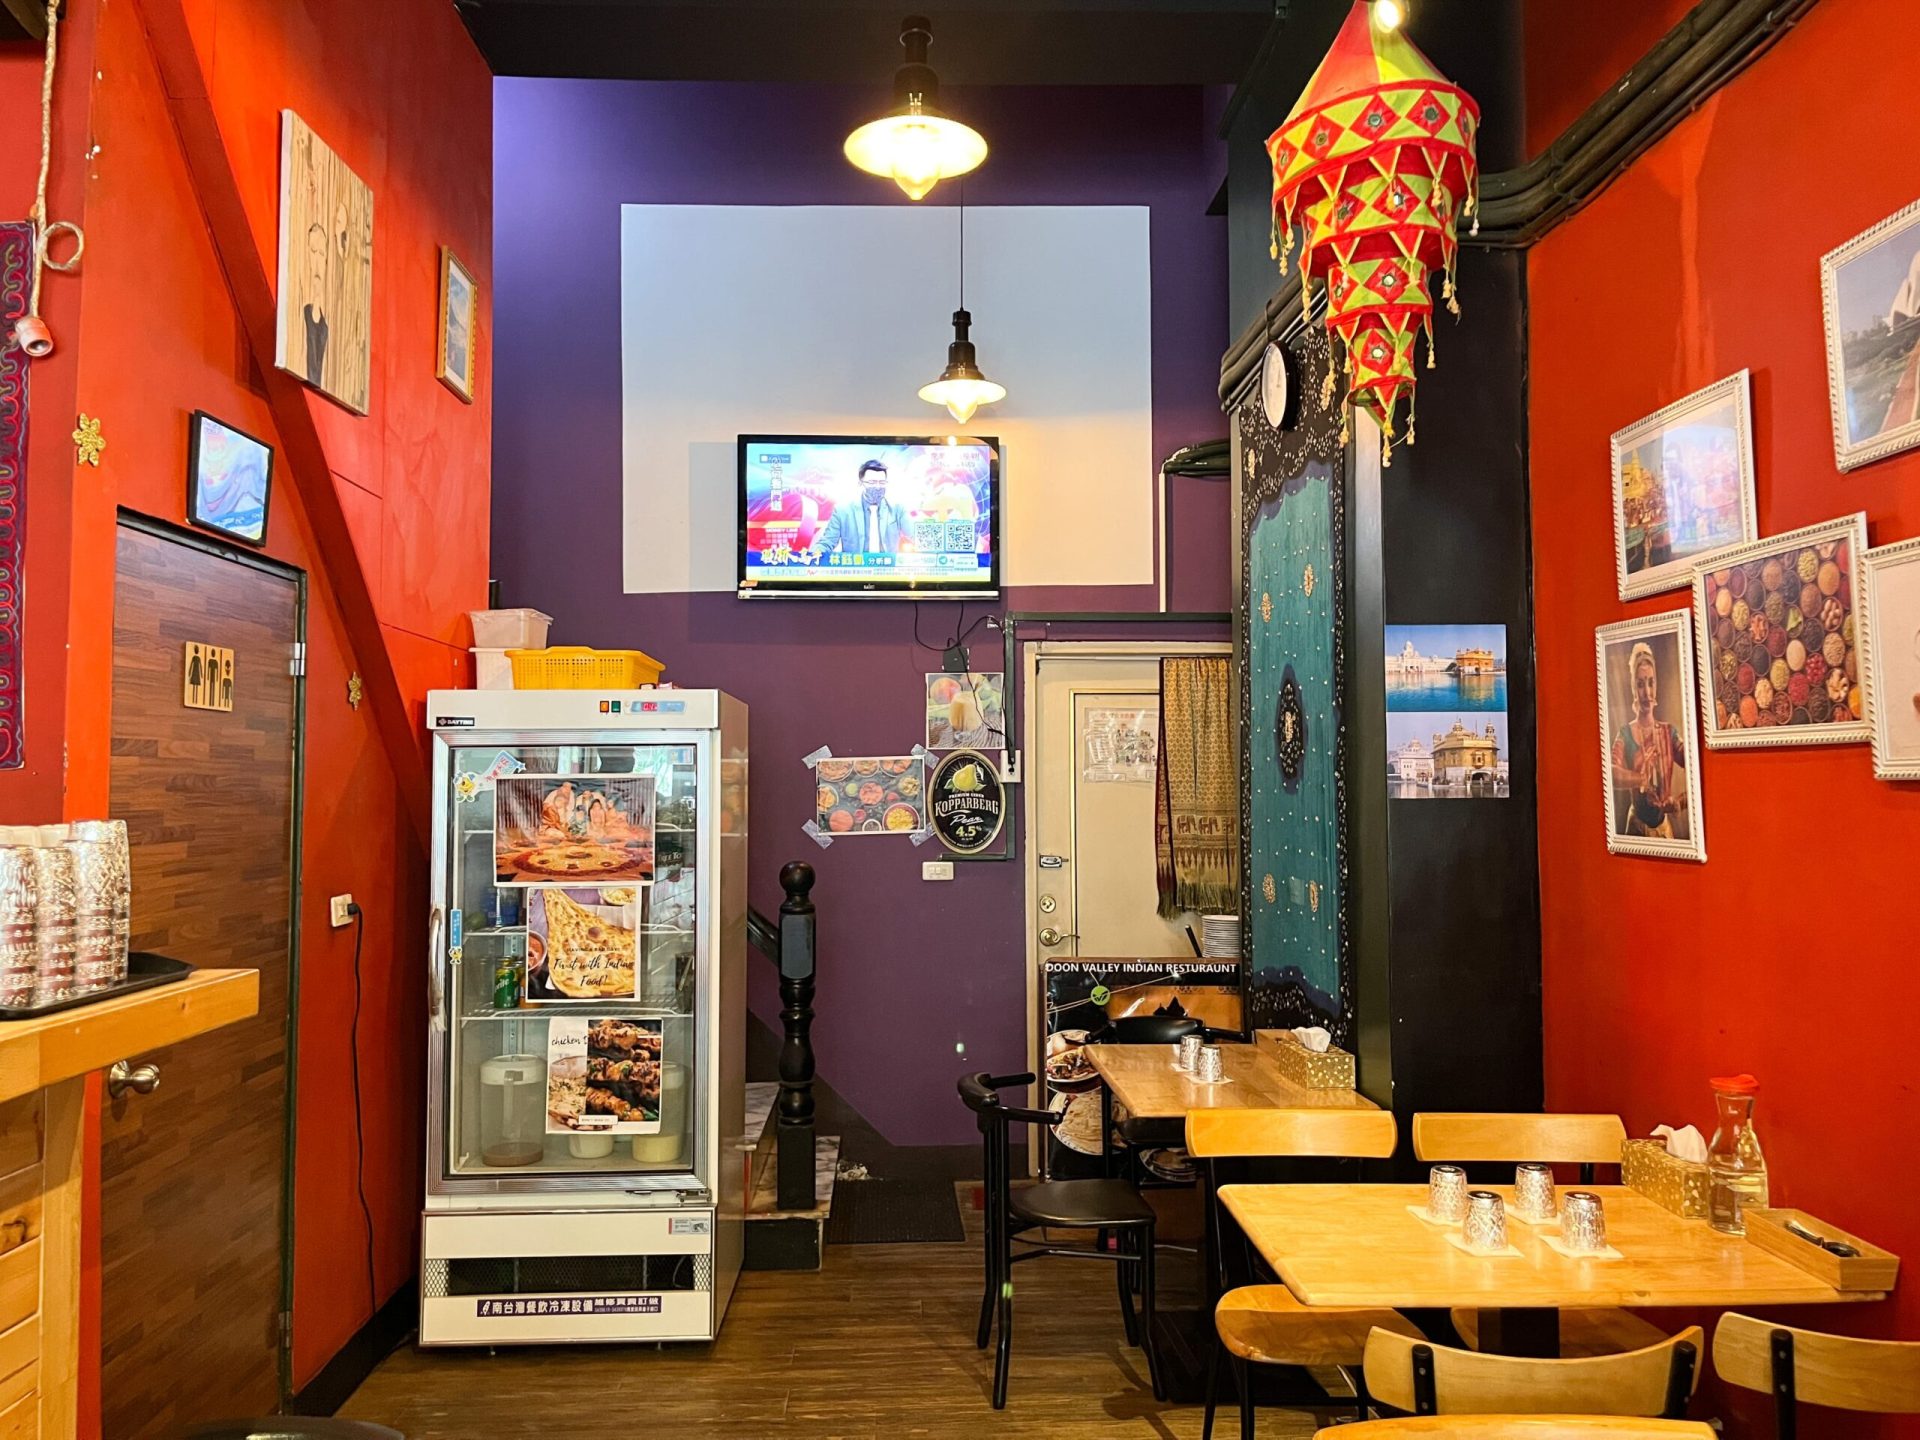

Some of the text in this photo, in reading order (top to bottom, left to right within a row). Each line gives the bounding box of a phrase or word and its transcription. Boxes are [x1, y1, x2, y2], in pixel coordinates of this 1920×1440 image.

[935, 797, 999, 817] KOPPARBERG
[1045, 963, 1237, 973] DOON VALLEY INDIAN RESTURAUNT
